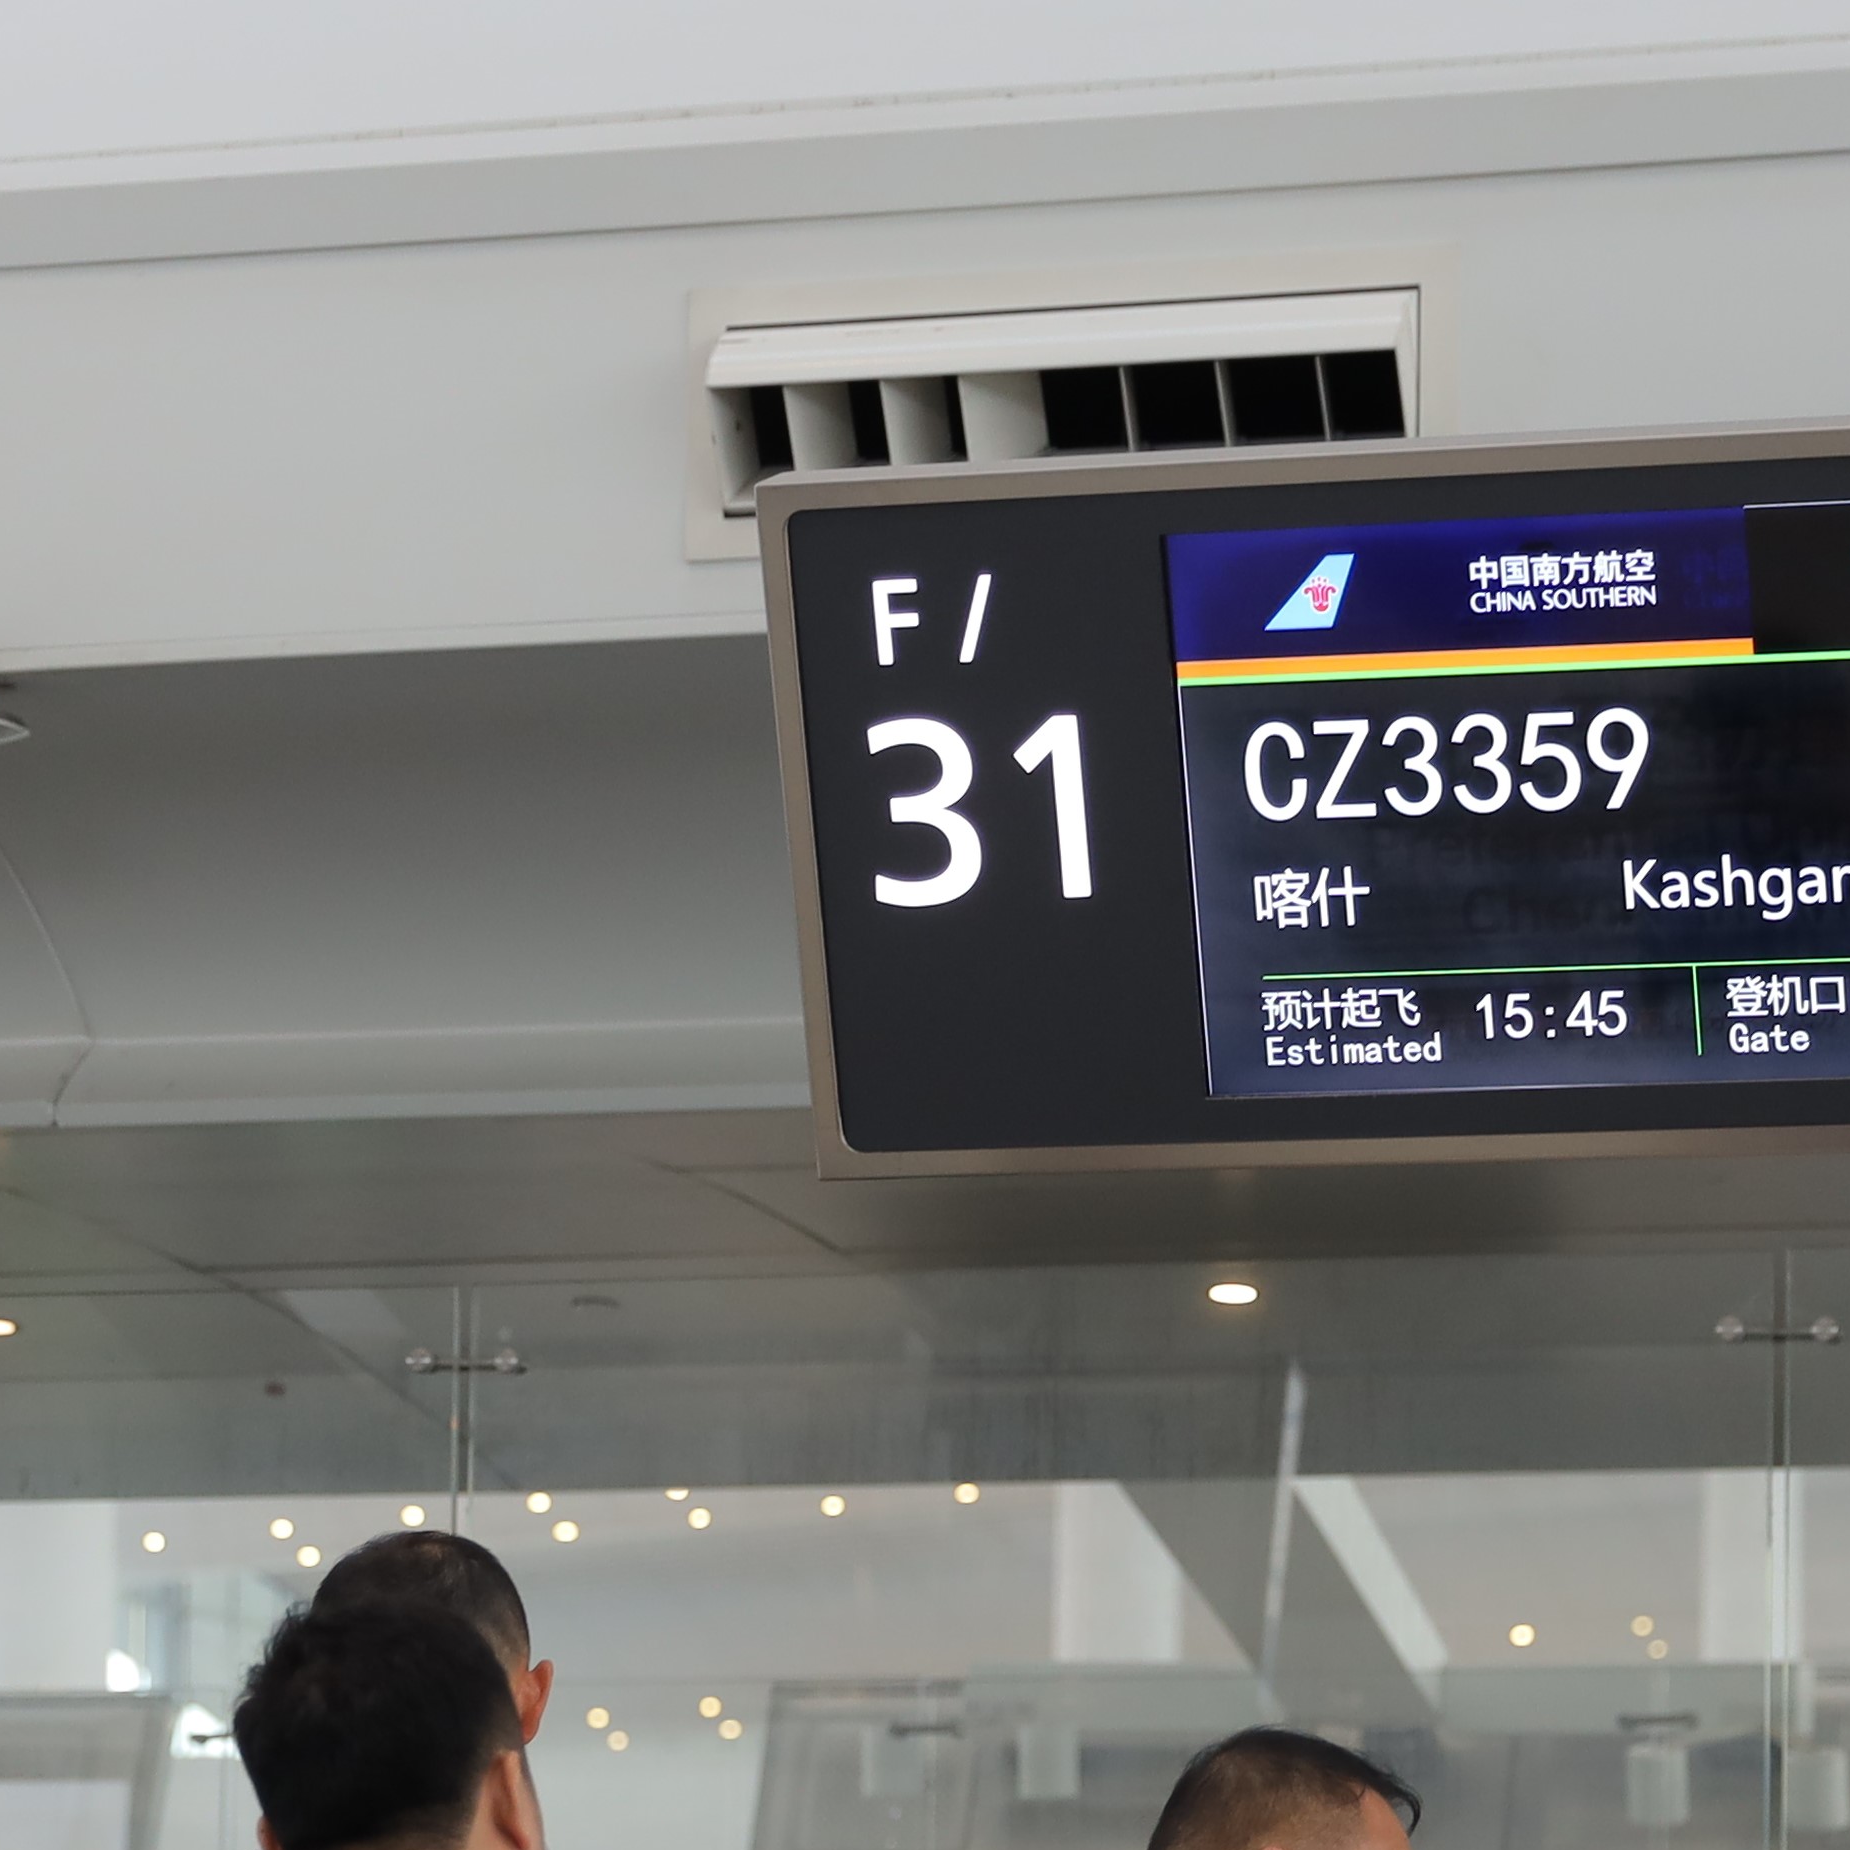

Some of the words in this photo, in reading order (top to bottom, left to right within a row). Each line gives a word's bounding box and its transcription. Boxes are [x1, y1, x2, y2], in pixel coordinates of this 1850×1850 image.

[1468, 549, 1655, 590] 中国南方航空
[1469, 588, 1536, 616] CHINA
[1543, 583, 1657, 612] SOUTHERN
[1244, 707, 1649, 824] CZ3359
[866, 713, 1093, 909] 31
[1254, 870, 1369, 929] 喀什
[1262, 987, 1421, 1032] 预计起飞
[1475, 990, 1627, 1042] 15:45
[1727, 975, 1846, 1020] 登机口
[1267, 1032, 1443, 1068] Estimated
[1729, 1021, 1810, 1055] Gate
